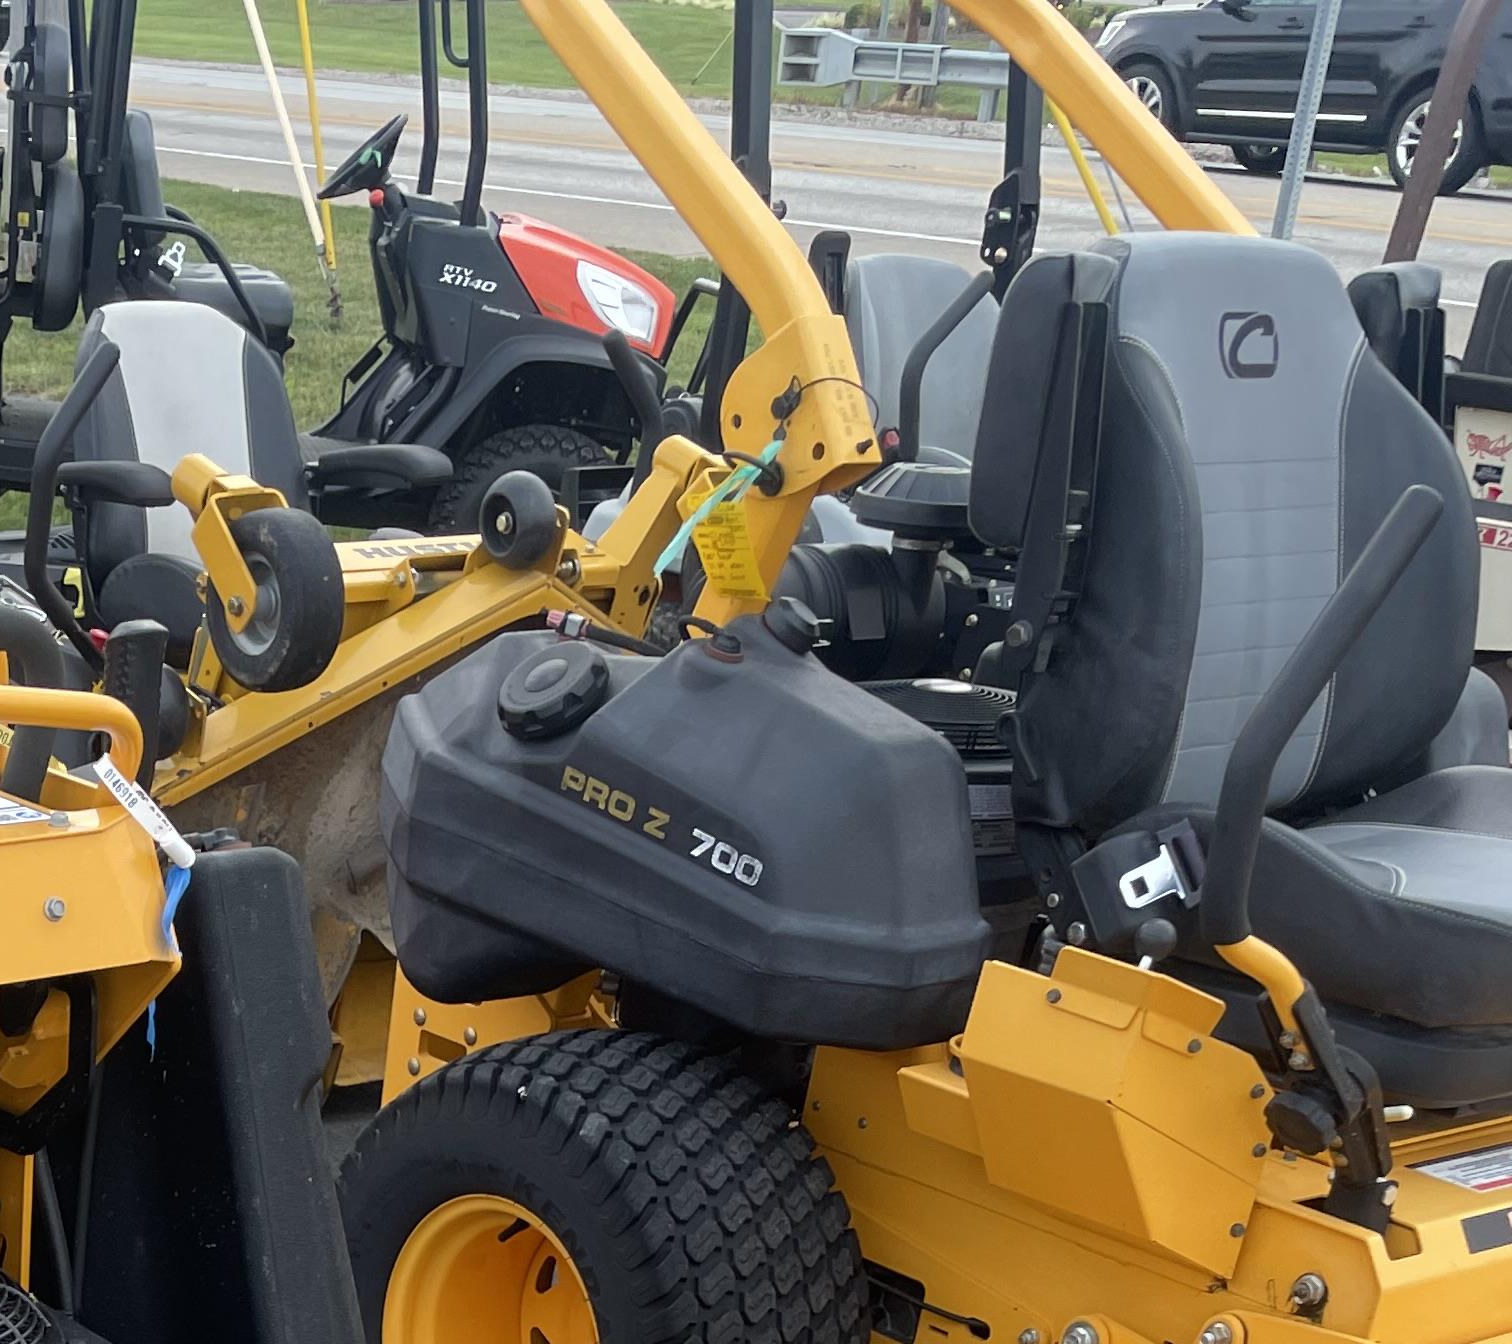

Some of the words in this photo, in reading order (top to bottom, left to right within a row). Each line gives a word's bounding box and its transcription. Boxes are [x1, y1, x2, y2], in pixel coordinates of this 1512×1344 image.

[442, 263, 474, 277] RTV
[438, 271, 498, 293] X1140
[560, 764, 637, 823] PRO
[642, 806, 671, 840] Z
[690, 827, 764, 887] 700
